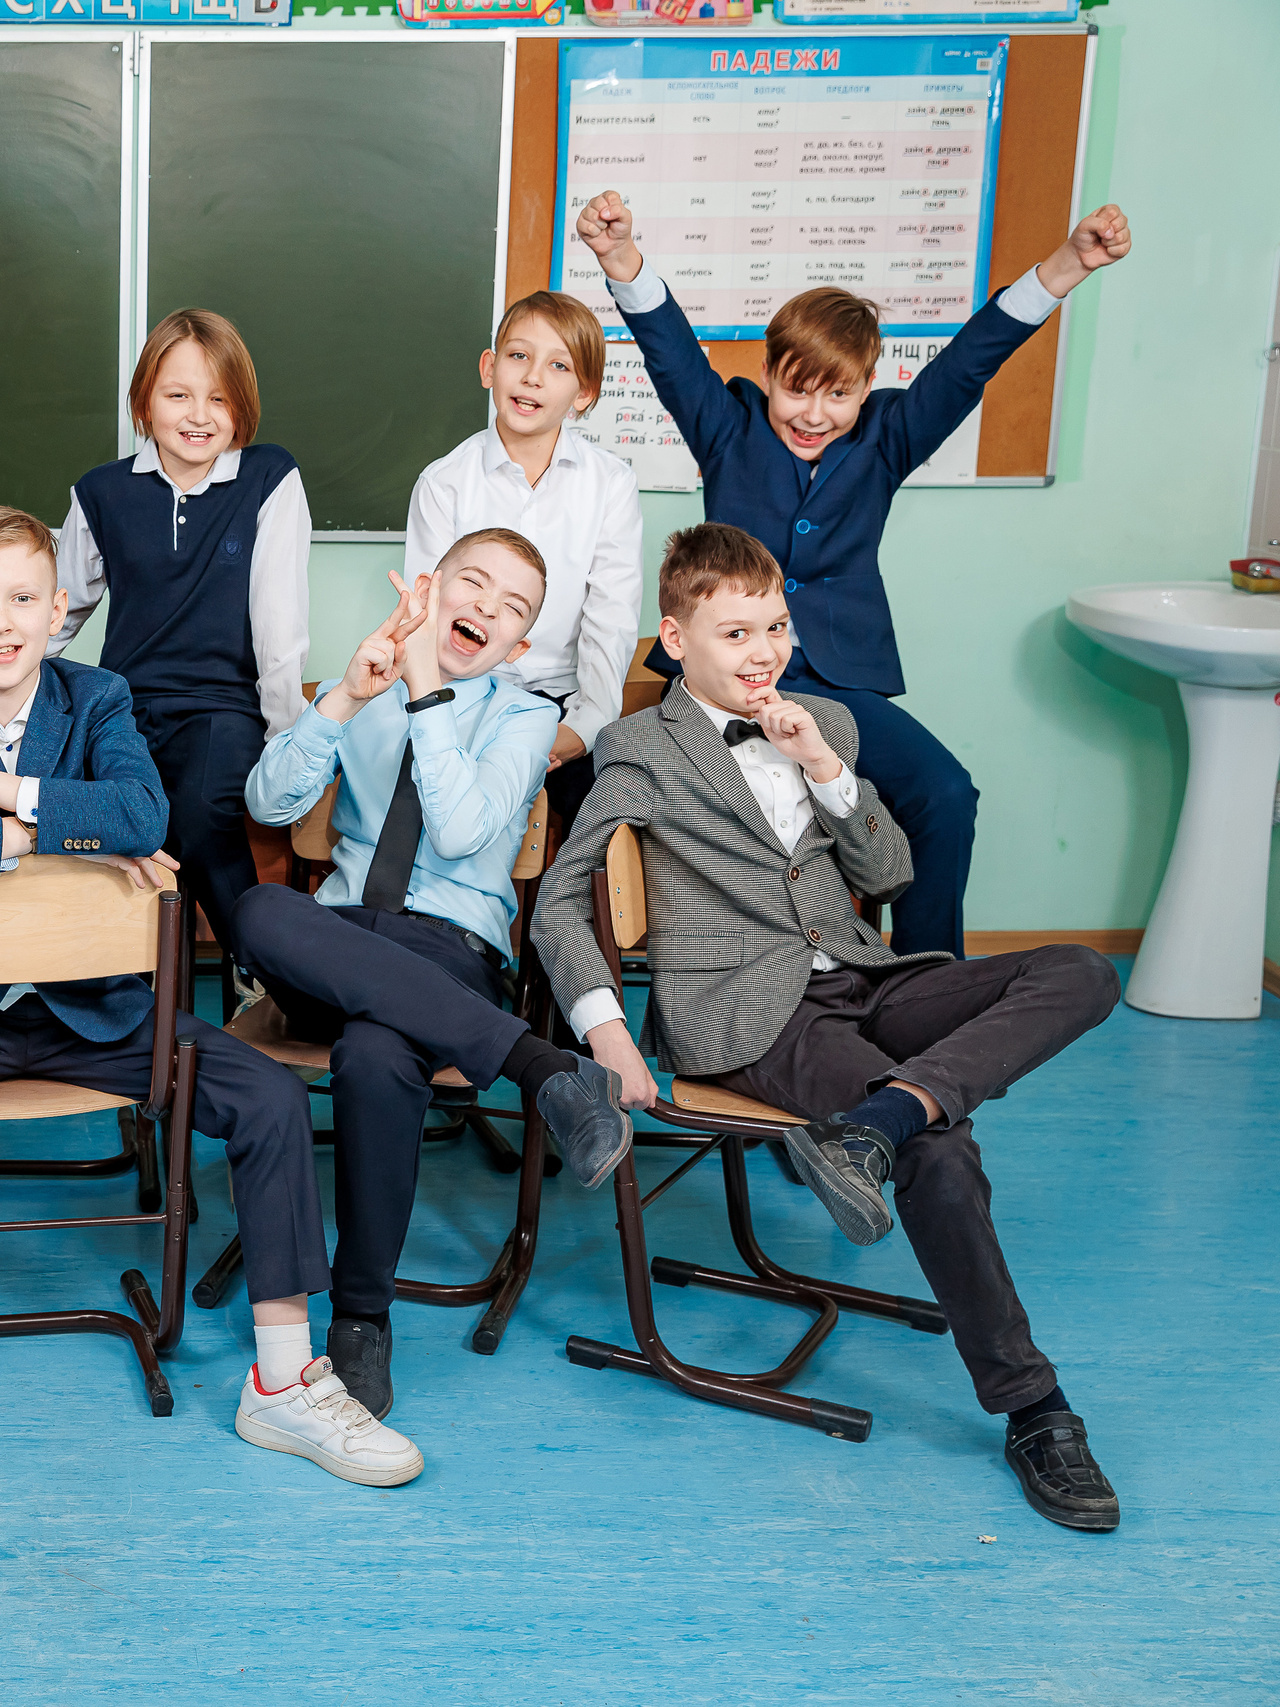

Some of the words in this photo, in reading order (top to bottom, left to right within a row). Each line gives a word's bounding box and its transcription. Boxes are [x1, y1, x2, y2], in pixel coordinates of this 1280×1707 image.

[710, 48, 840, 75] ПАДЕЖИ
[754, 86, 786, 95] ВОПРОС
[826, 85, 871, 94] ПРЕДЛОГИ
[924, 84, 963, 92] ПРИМЕРЫ
[576, 114, 656, 124] Именительный
[574, 155, 645, 165] Родительный
[675, 269, 712, 278] любуюсь
[893, 344, 920, 362] нщ
[927, 344, 944, 362] р
